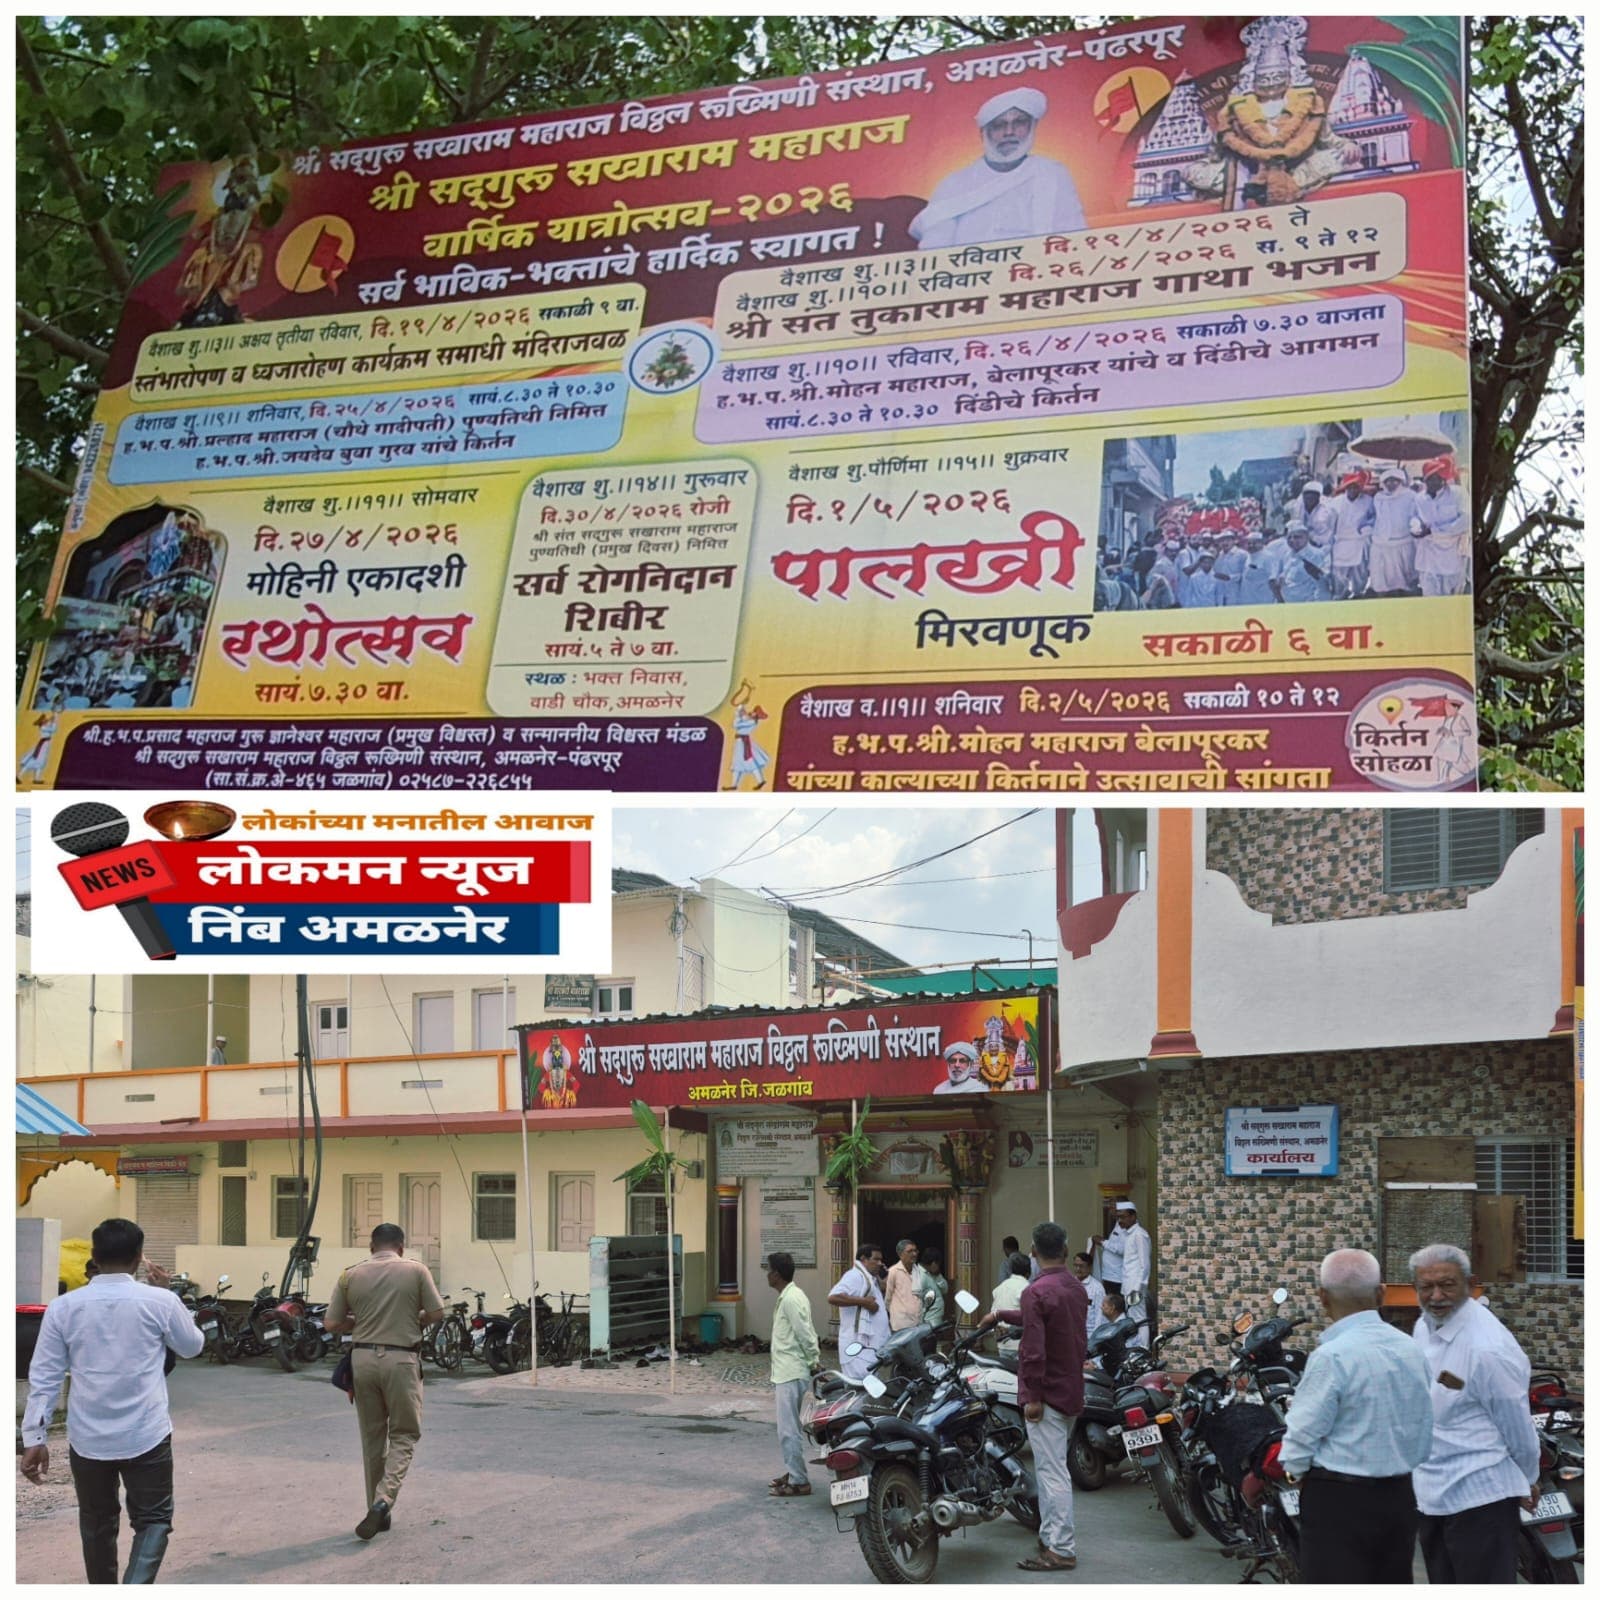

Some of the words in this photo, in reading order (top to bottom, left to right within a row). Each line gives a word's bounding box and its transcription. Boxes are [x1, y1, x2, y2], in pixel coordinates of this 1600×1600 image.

[413, 128, 513, 160] सखाराम
[521, 114, 614, 146] महाराज
[827, 68, 935, 103] संस्थान,
[368, 171, 419, 212] श्री
[568, 139, 738, 186] सखाराम
[749, 114, 910, 162] महाराज
[422, 215, 539, 259] वार्षिक
[779, 266, 844, 287] वैशाख
[948, 245, 1024, 268] रविवार
[1288, 205, 1310, 227] ते
[358, 270, 406, 305] सर्व
[648, 234, 742, 274] हार्दिक
[751, 225, 860, 260] स्वागत
[736, 293, 797, 312] वैशाख
[919, 270, 992, 293] रविवार
[1256, 238, 1284, 255] स.
[1319, 228, 1335, 248] ते
[1346, 227, 1378, 243] १२
[725, 313, 771, 340] श्री
[783, 307, 839, 335] संत
[851, 296, 989, 335] तुकाराम
[1000, 278, 1142, 312] महाराज
[1153, 266, 1253, 294] गाथा
[1266, 250, 1380, 281] भजन
[148, 339, 184, 357] वैशाख
[239, 333, 270, 349] अक्षय
[276, 326, 313, 350] तृतीया
[320, 323, 363, 342] रविवार,
[539, 297, 595, 321] सकाळी
[616, 298, 639, 312] वा.
[722, 365, 778, 384] वैशाख
[887, 347, 960, 368] रविवार,
[1176, 313, 1247, 340] सकाळी
[1254, 314, 1308, 333] ७.३०
[1316, 304, 1386, 325] वाजता
[134, 364, 226, 394] स्तंभारोपण
[231, 366, 248, 383] व
[252, 353, 347, 381] ध्वजारोहण
[351, 343, 430, 375] कार्यक्रम
[437, 332, 506, 364] समाधी
[512, 329, 630, 357] मंदिराजवळ
[887, 373, 977, 393] महाराज,
[987, 364, 1100, 385] बेलापूरकर
[1108, 350, 1159, 372] यांचे
[1167, 352, 1186, 367] व
[1195, 339, 1271, 365] दिंडीचे
[1280, 332, 1380, 356] आगमन
[134, 415, 178, 432] वैशाख
[247, 404, 305, 423] शनिवार,
[548, 381, 559, 400] ते
[858, 403, 873, 423] ते
[880, 403, 938, 421] १०.३०
[954, 391, 1024, 415] दिंडीचे
[1032, 384, 1100, 407] किर्तन
[257, 427, 317, 444] महाराज
[324, 420, 368, 441] (चौथे
[463, 407, 543, 434] पुण्यतिथी
[549, 402, 608, 421] निमित्त
[339, 444, 371, 465] बुवा
[378, 441, 415, 462] गुरव
[421, 435, 458, 454] यांचे
[463, 431, 516, 450] किर्तन
[789, 465, 839, 482] वैशाख
[1003, 448, 1069, 472] शुक्रवार
[263, 494, 313, 514] वैशाख
[412, 485, 479, 507] सोमवार
[532, 480, 586, 499] वैशाख
[684, 470, 748, 494] गुरूवार
[690, 495, 730, 516] रोजी
[529, 543, 585, 561] पुण्यतिथी
[592, 540, 631, 558] (प्रमुख
[637, 540, 679, 554] दिवस)
[686, 537, 728, 550] निमित्त
[533, 527, 548, 542] श्री
[554, 527, 575, 541] संत
[629, 524, 681, 538] सखाराम
[687, 522, 738, 535] महाराज
[771, 510, 1085, 602] पालखी
[246, 559, 338, 598] मोहिनी
[347, 553, 467, 596] एकादशी
[514, 564, 570, 596] सर्व
[578, 562, 738, 594] रोगनिदान
[564, 601, 669, 632] शिबीर
[915, 609, 1094, 658] मिरवणूक
[222, 603, 474, 667] रथोत्सव
[610, 636, 625, 656] ते
[652, 641, 678, 656] वा.
[1143, 618, 1273, 657] सकाळी
[1288, 628, 1311, 655] ६
[1326, 625, 1384, 649] वा.
[376, 680, 408, 701] वा.
[525, 671, 567, 686] स्थळ
[584, 671, 622, 685] भक्त
[630, 668, 688, 686] निवास,
[530, 693, 565, 710] वाडी
[800, 693, 854, 718] वैशाख
[935, 690, 1004, 716] शनिवार
[1183, 681, 1250, 709] सकाळी
[1257, 689, 1282, 707] १०
[1290, 682, 1304, 706] ते
[1313, 687, 1340, 706] १२
[186, 729, 235, 745] महाराज
[241, 728, 264, 748] गुरू
[269, 725, 323, 744] ज्ञानेश्वर
[328, 728, 383, 745] महाराज
[387, 726, 433, 748] (प्रमुख
[503, 727, 513, 741] व
[521, 726, 600, 744] सन्माननीय
[606, 723, 660, 744] विश्वस्त
[666, 722, 707, 742] मंडळ
[1030, 731, 1126, 754] महाराज
[1134, 723, 1270, 759] बेलापूरकर
[1354, 721, 1429, 748] किर्तन
[134, 745, 151, 764] श्री
[206, 750, 258, 766] सखाराम
[263, 750, 314, 768] महाराज
[429, 747, 486, 768] संस्थान,
[1351, 749, 1434, 773] सोहळा
[332, 767, 393, 789] जळगांव)
[787, 763, 854, 791] यांच्या
[861, 769, 980, 791] काल्याच्या
[986, 760, 1089, 791] किर्तनाने
[1236, 760, 1332, 791] सांगता
[578, 1033, 597, 1074] श्री
[648, 1040, 707, 1071] सखाराम
[710, 1037, 764, 1069] महाराज
[767, 1023, 808, 1072] विठ्ठल
[885, 1014, 941, 1059] संस्थान
[689, 1080, 737, 1100] अमळनेर
[1247, 1149, 1315, 1164] कार्यालय
[1128, 1433, 1159, 1448] 9391
